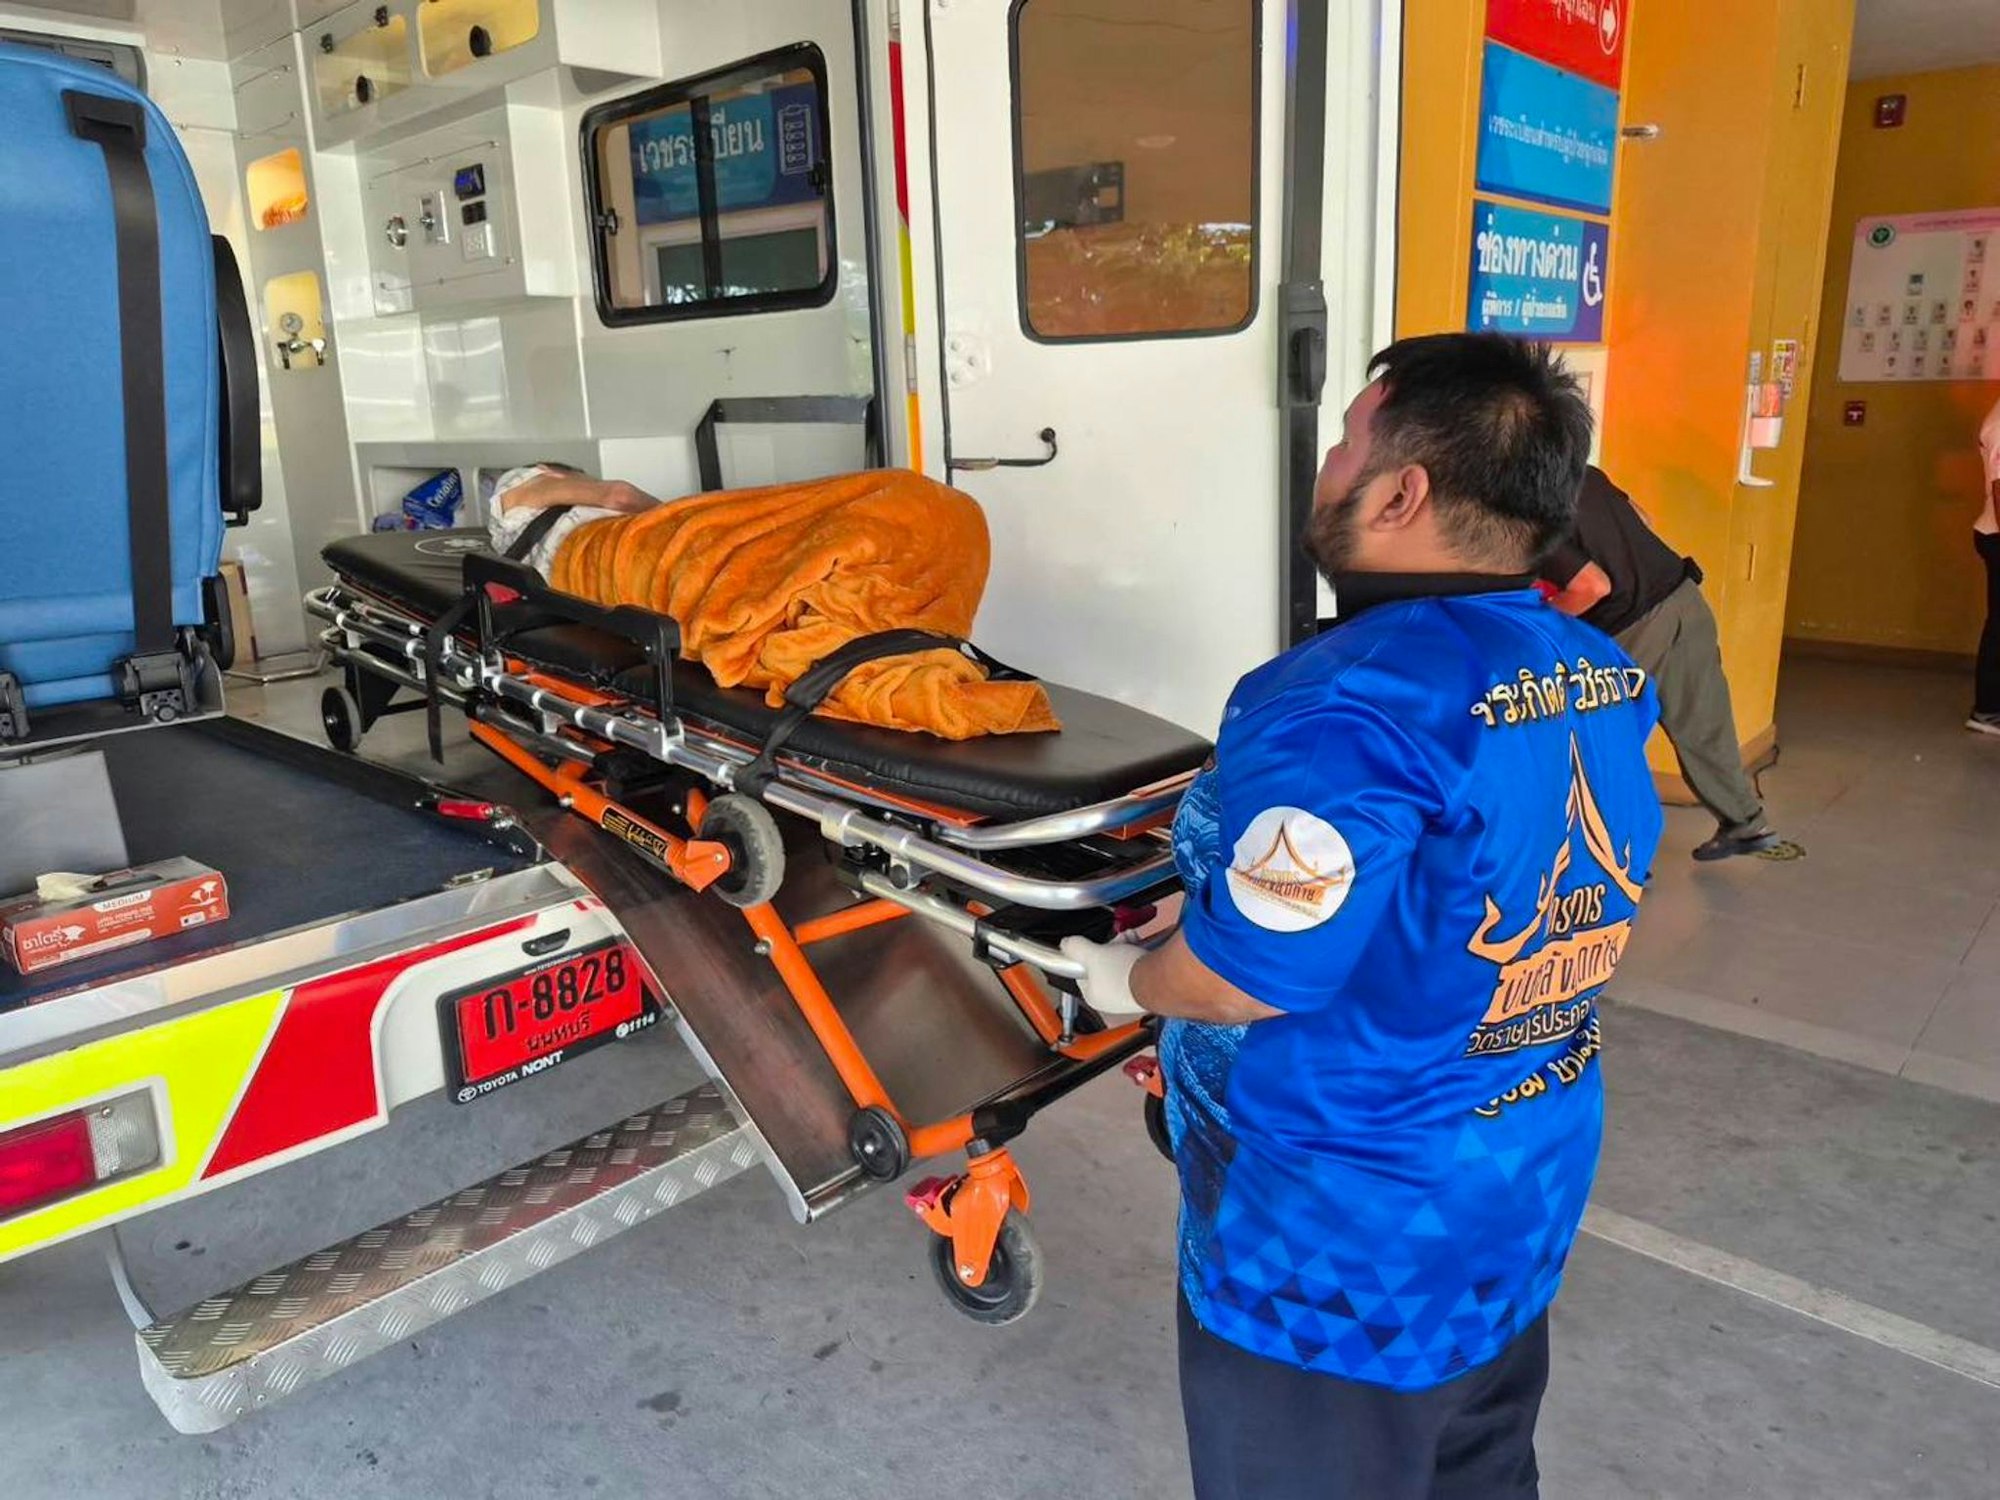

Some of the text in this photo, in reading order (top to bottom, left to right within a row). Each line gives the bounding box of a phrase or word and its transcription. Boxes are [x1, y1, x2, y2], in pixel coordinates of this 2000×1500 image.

[640, 106, 765, 173] เวชระบียน
[1477, 214, 1578, 281] ช่องทางด่วน
[483, 950, 626, 1040] ก-8828
[478, 1050, 564, 1094] TOYOTA NONT
